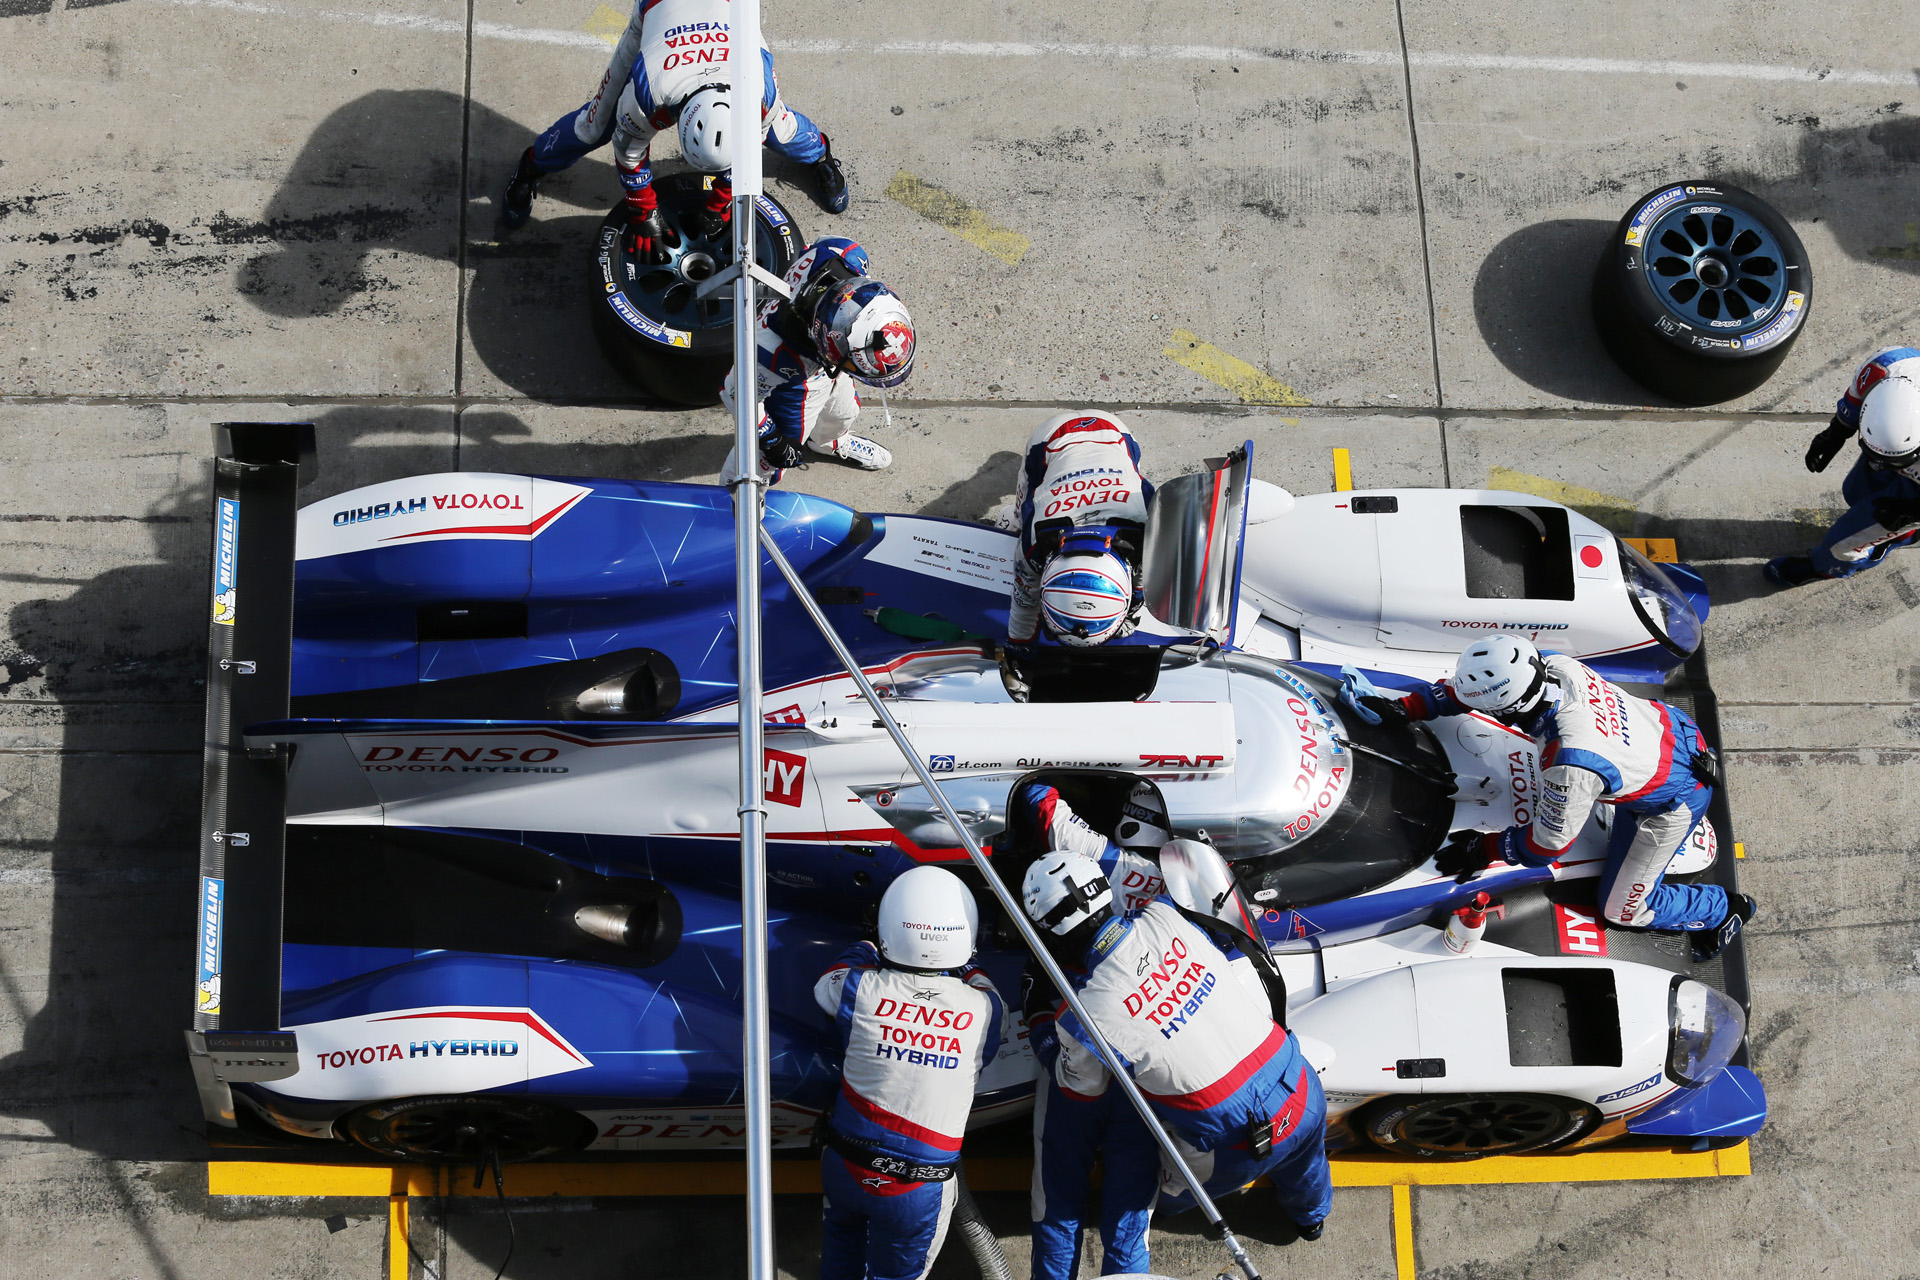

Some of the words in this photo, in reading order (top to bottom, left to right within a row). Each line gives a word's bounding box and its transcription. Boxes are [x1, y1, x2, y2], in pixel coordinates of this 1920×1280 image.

[664, 33, 729, 49] OYOTA
[663, 48, 730, 71] ENSO
[754, 195, 784, 222] HELIN
[1638, 188, 1682, 224] MICHELIN
[611, 296, 664, 338] MICHELIN
[1745, 313, 1792, 347] MICHELIN
[852, 346, 871, 371] DENSO
[1050, 478, 1124, 496] TOYOTA
[333, 497, 427, 527] HYBRID
[432, 493, 525, 510] TOYOTA
[1045, 490, 1130, 517] DENSO
[220, 501, 235, 587] MICHELIN
[913, 535, 938, 546] TAKATA
[1441, 620, 1499, 629] TOYOTA
[1531, 631, 1539, 641] 1
[1463, 691, 1482, 699] TOYOTA
[1481, 678, 1511, 695] HYBRID
[1584, 664, 1609, 738] DENSO
[1274, 668, 1345, 755] HYBRID
[1602, 680, 1620, 738] TOYOTA
[363, 746, 560, 762] DENSO
[1139, 754, 1224, 768] ZENT
[1286, 698, 1318, 801] DENSO
[361, 764, 455, 772] TOYOTA
[462, 764, 570, 774] HYBRID
[764, 758, 803, 797] HY
[931, 760, 952, 771] ZF
[957, 761, 1002, 770] zf.com
[1526, 752, 1537, 792] Racing
[1508, 750, 1530, 828] OYOTA
[1122, 802, 1157, 823] uvex
[1283, 767, 1345, 839] TOYOTA
[787, 872, 814, 882] ACTION
[1122, 870, 1169, 895] DEN
[1620, 883, 1645, 922] DENSO
[204, 880, 219, 973] MICHELIN
[902, 921, 932, 930] TOYOTA
[933, 923, 966, 932] HYBRID
[919, 932, 949, 942] uvex
[1567, 908, 1600, 953] HY
[1123, 937, 1188, 1019] DENSO
[1145, 961, 1206, 1026] TOYOTA
[1160, 972, 1217, 1040] HYBRID
[874, 998, 974, 1031] DENSO
[210, 1039, 269, 1047] Mobil
[879, 1025, 963, 1054] TOYOTA
[317, 1044, 404, 1070] TOYOTA
[409, 1039, 519, 1059] HYBRID
[875, 1043, 960, 1070] HYBRID
[1602, 1076, 1659, 1102] AISIN
[392, 1097, 459, 1112] MICHELIN
[1377, 1110, 1405, 1135] MICHELIN
